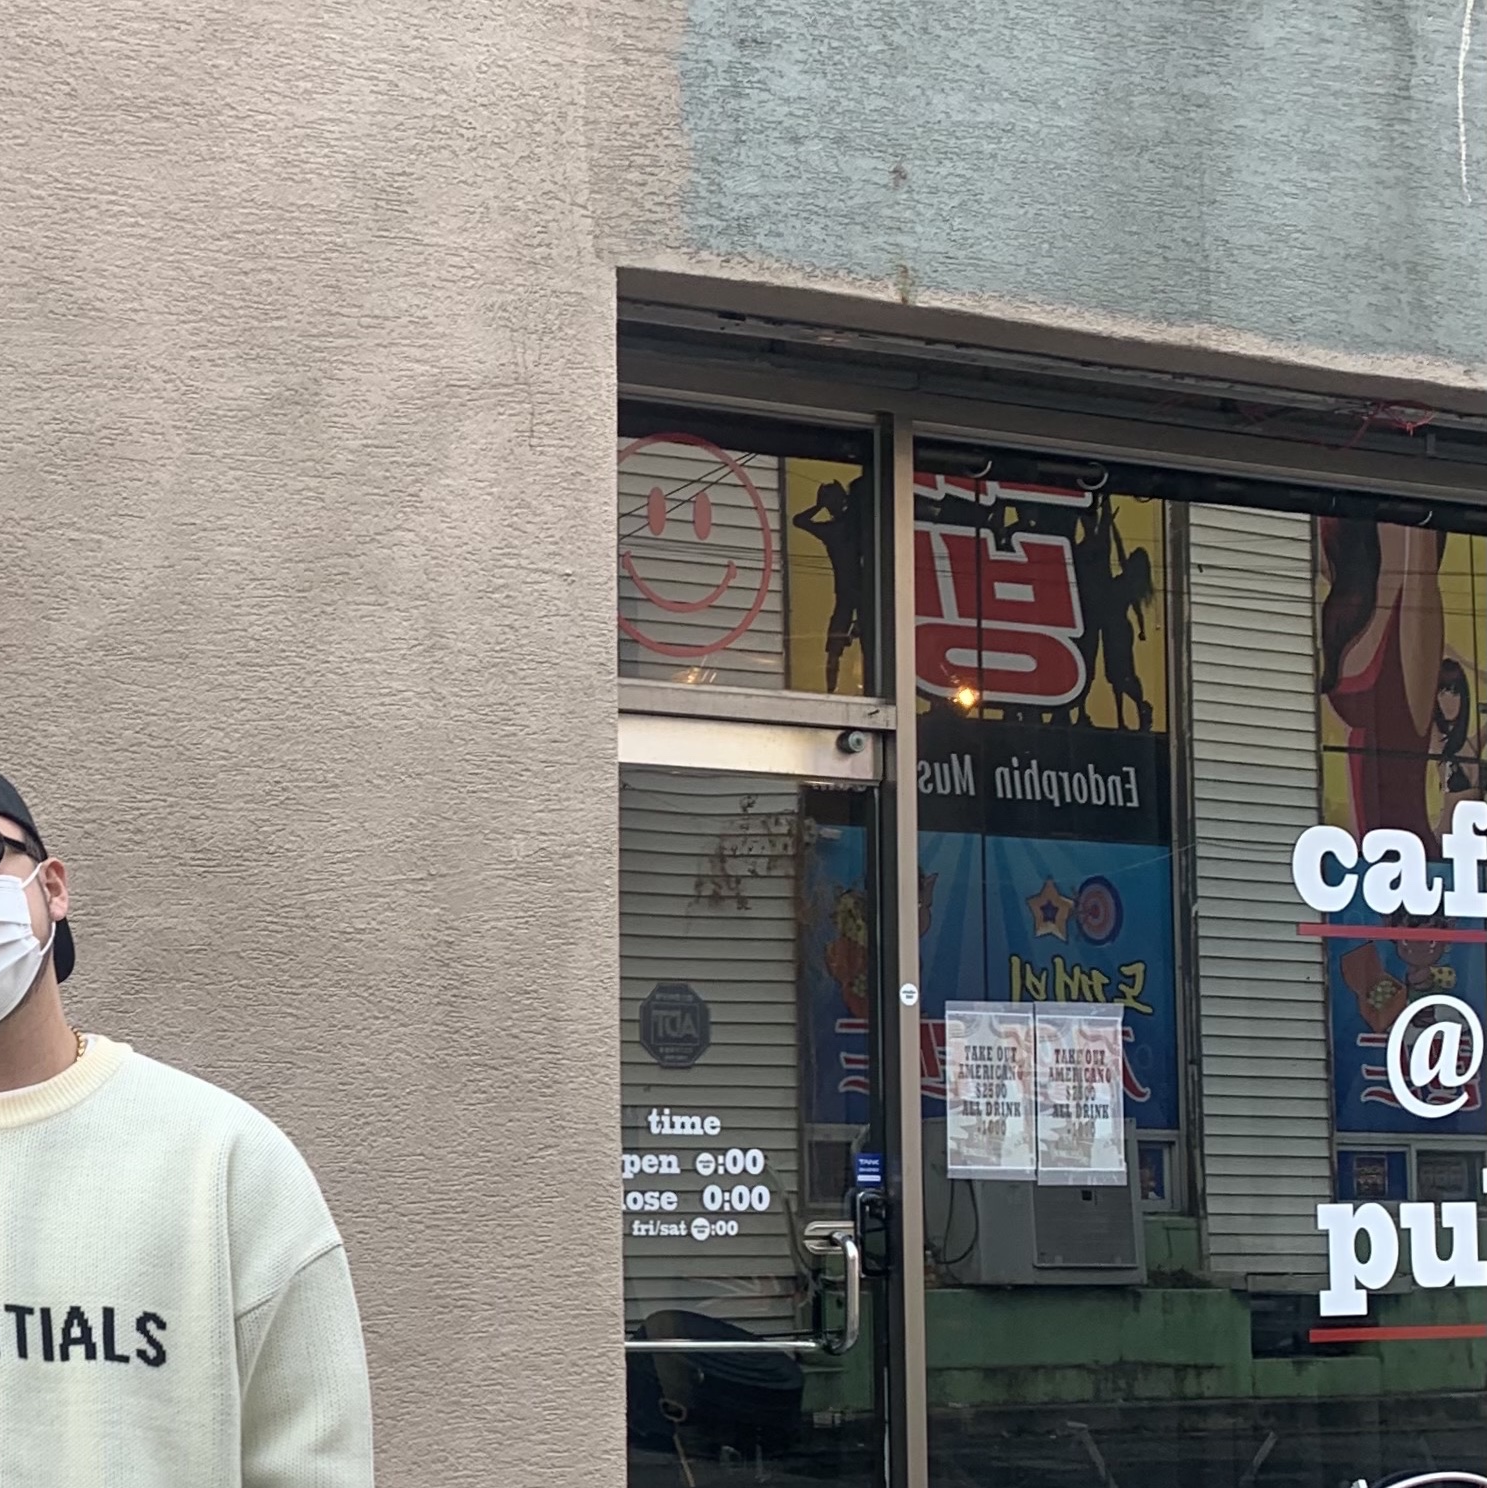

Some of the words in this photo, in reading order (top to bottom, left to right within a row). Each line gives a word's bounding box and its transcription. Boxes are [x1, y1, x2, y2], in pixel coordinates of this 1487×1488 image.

[964, 1045, 993, 1062] TAKE
[997, 1045, 1017, 1063] OUT
[1054, 1048, 1083, 1065] TAKE
[1085, 1049, 1105, 1065] OUT
[1387, 994, 1485, 1119] @
[1048, 1066, 1112, 1083] AMERICANO
[962, 1100, 982, 1117] ALL
[985, 1101, 1022, 1117] DRINK
[1075, 1102, 1110, 1119] DRINK
[648, 1108, 721, 1136] time
[622, 1153, 681, 1179] pen
[621, 1190, 679, 1212] ose
[702, 1184, 771, 1212] 0:00
[632, 1220, 688, 1237] fri/sat
[1316, 1168, 1487, 1317] pu
